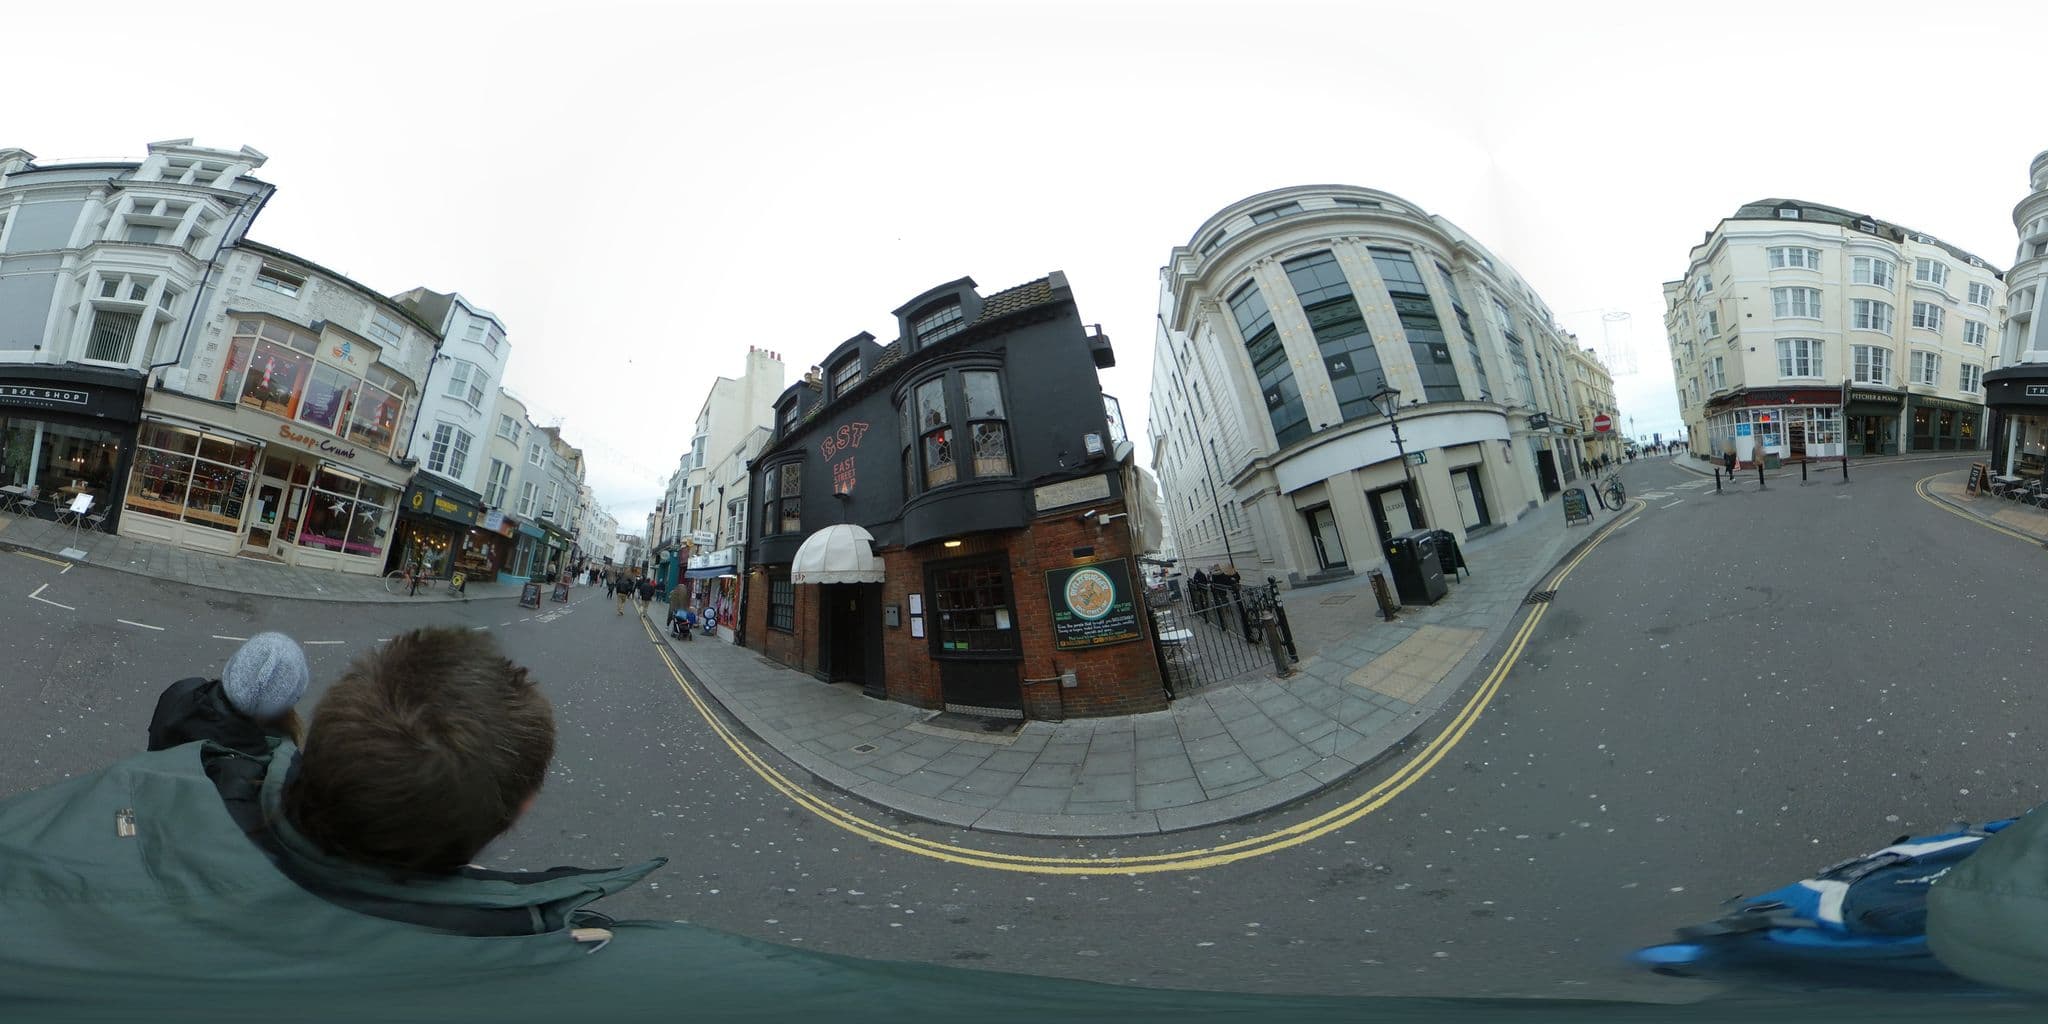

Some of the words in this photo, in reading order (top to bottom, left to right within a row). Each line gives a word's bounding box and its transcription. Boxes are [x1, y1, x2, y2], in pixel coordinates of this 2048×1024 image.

[45, 391, 79, 401] SHOP
[320, 440, 355, 459] Crumb
[833, 456, 854, 475] EAST
[833, 468, 856, 485] STREET
[834, 478, 856, 494] TAP
